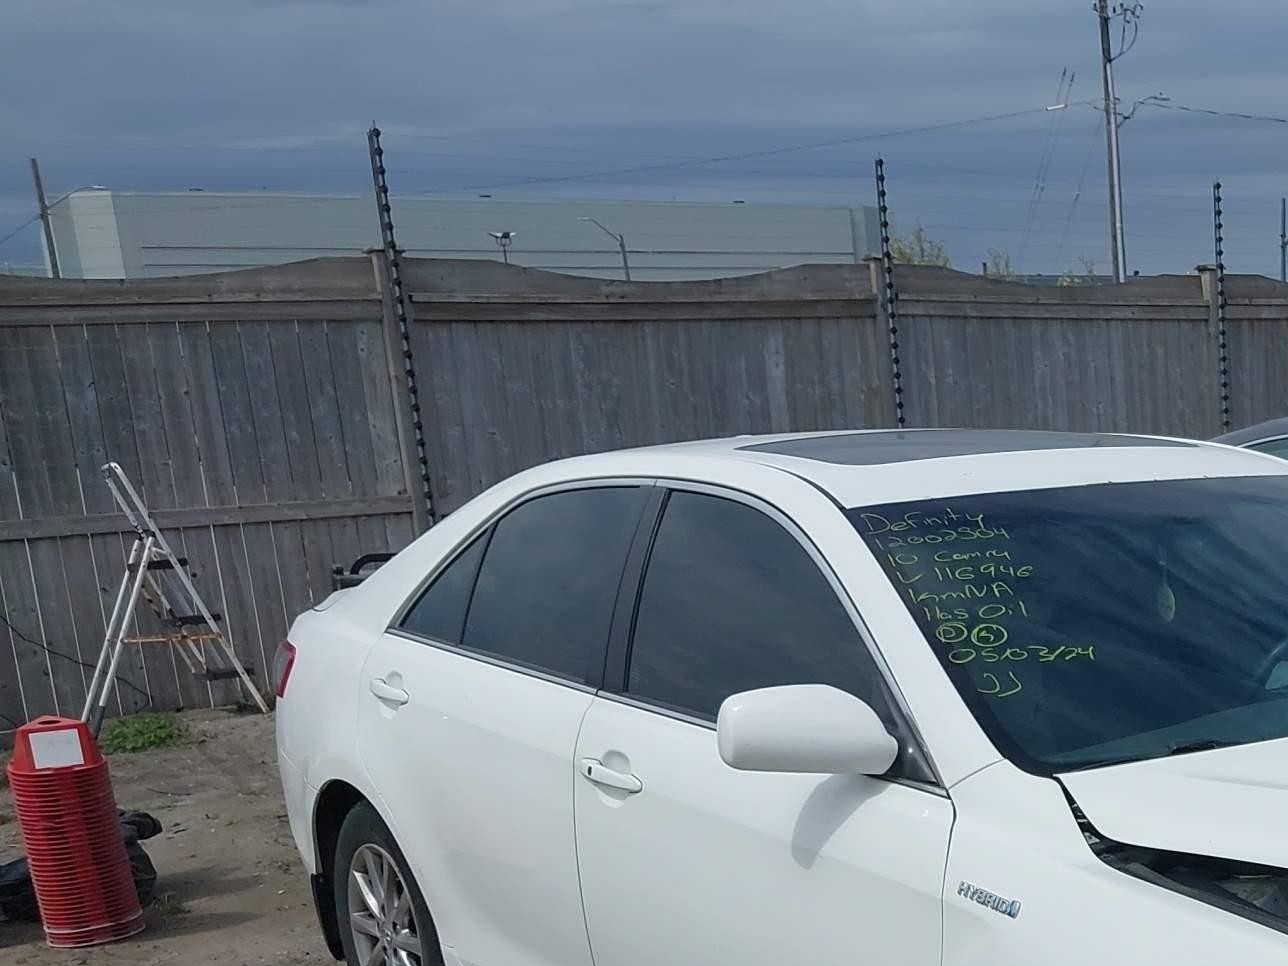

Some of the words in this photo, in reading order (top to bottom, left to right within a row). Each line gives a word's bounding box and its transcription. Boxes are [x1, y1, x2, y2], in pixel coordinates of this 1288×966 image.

[874, 526, 1010, 550] 12002504
[934, 563, 1033, 582] 116946
[979, 600, 1028, 619] Oil
[957, 880, 1010, 915] HYBRID
